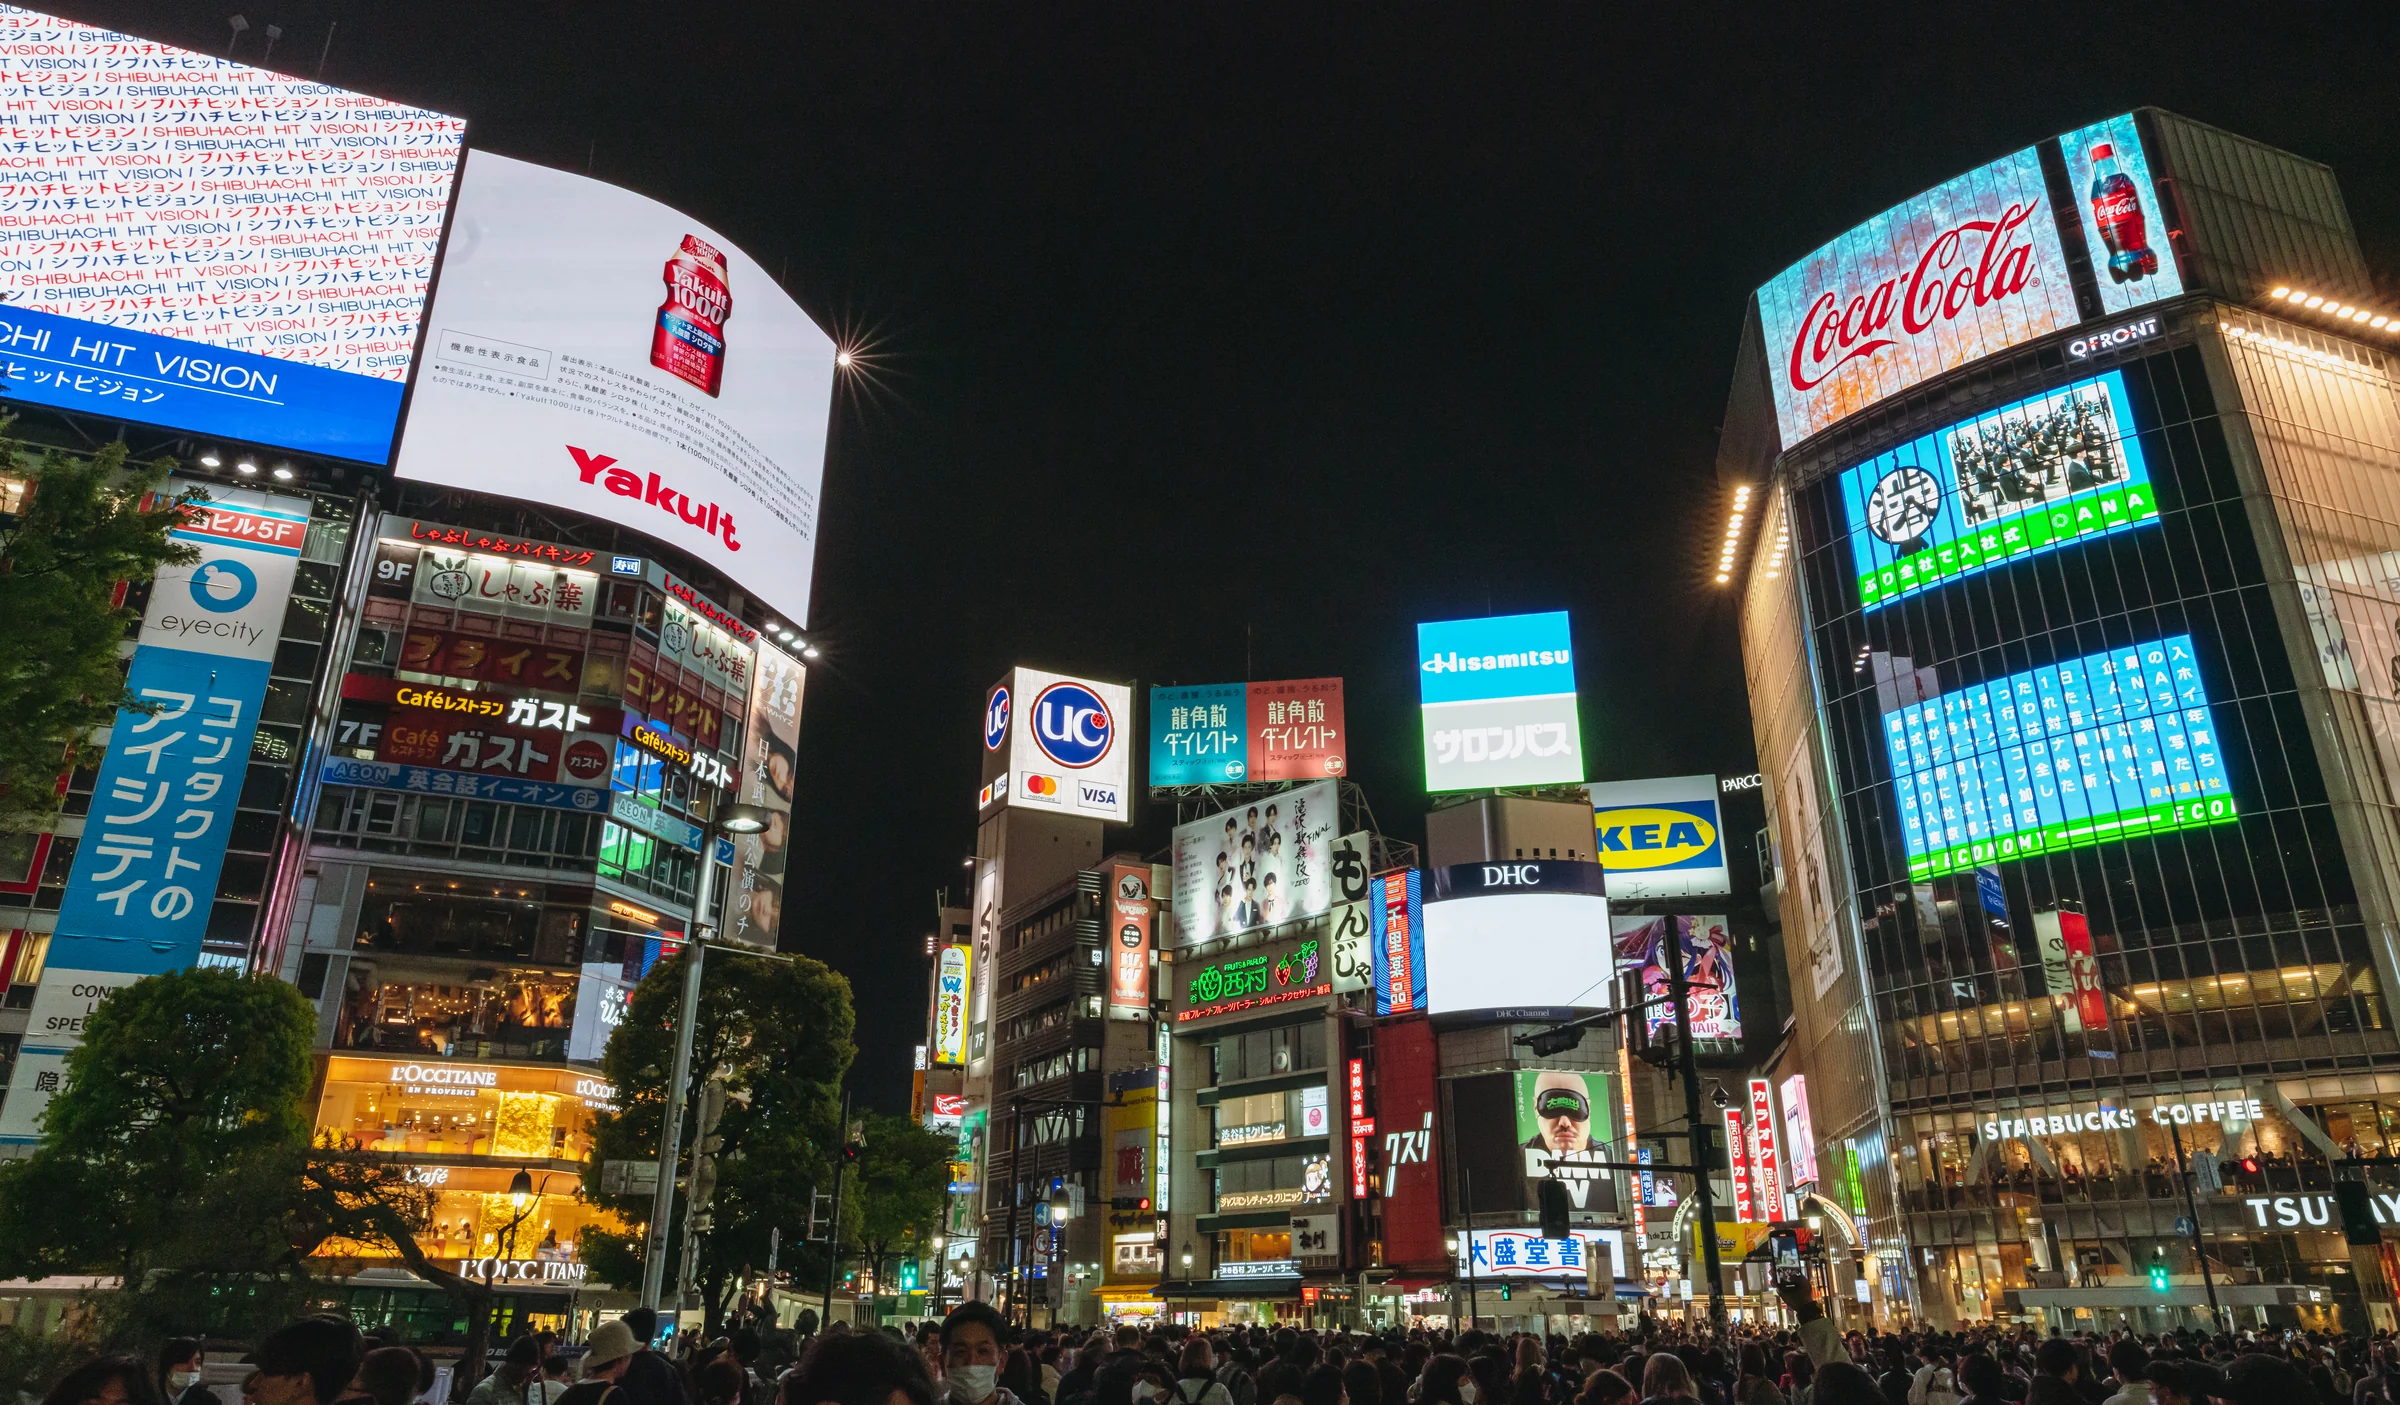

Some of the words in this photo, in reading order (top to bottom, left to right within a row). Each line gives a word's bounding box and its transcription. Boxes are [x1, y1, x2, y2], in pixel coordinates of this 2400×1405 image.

[105, 72, 219, 83] SHIBUHACHI
[228, 72, 254, 82] HIT
[7, 100, 36, 111] HIT
[49, 99, 113, 111] VISION
[132, 97, 319, 111] シブハチヒットビジョン
[154, 125, 265, 137] SHIBUHACHI
[275, 124, 300, 135] HIT
[312, 123, 369, 135] VISION
[56, 156, 86, 167] HIT
[98, 155, 161, 167] VISION
[180, 149, 365, 165] シブハチヒットビジョン
[672, 265, 728, 311] Yakult
[670, 283, 725, 326] 1000
[204, 323, 232, 335] HIT
[244, 319, 306, 333] VISION
[70, 336, 136, 367] HIT
[154, 351, 279, 396] VISION
[450, 342, 540, 368] 機能性表示食品
[565, 444, 742, 553] Yakult
[2077, 491, 2145, 523] ANA
[411, 521, 597, 567] しゃぶしゃぶバイキング
[377, 560, 413, 581] 9F
[614, 559, 640, 574] 寿司
[480, 569, 583, 612] しゃぶ葉
[664, 573, 757, 643] しゃぶしゃぶバイキング
[161, 615, 264, 646] eyecity
[407, 635, 574, 681] プライス
[692, 630, 747, 684] しゃぶ葉
[1422, 649, 1569, 674] Hisamitsu
[396, 687, 504, 717] Caféレストラン
[507, 698, 591, 732] ガスト
[626, 666, 717, 735] コンタクト
[1267, 699, 1325, 725] 龍角散
[988, 699, 1009, 737] UC
[1042, 701, 1105, 748] UC
[1172, 703, 1228, 730] 龍角散
[340, 720, 382, 746] 7F
[391, 727, 440, 747] Café
[1163, 730, 1239, 756] ダイレクト
[1260, 725, 1337, 751] ダイレクト
[1433, 722, 1573, 764] サロンパス
[390, 745, 437, 759] レストラン
[441, 731, 549, 774] ガスト
[569, 756, 603, 770] ガスト
[1172, 758, 1201, 766] スティック
[1269, 753, 1299, 762] スティック
[691, 752, 733, 789] ガスト
[332, 762, 390, 784] AEON
[407, 770, 565, 804] 英会話イーオン
[575, 791, 597, 807] 6F
[995, 778, 1008, 794] VISA
[1081, 787, 1117, 805] VISA
[2149, 777, 2222, 799] 時事通信社
[91, 688, 196, 917] アイシティ
[149, 696, 243, 921] コンタクトの
[618, 799, 648, 825] AEON
[1306, 822, 1332, 845] FINAL
[1944, 831, 2048, 868] ECONOMY
[1483, 865, 1540, 887] DHC
[1332, 839, 1371, 985] もんじゃ
[1384, 880, 1407, 1005] 三千里薬品
[72, 984, 114, 998] CON
[1224, 966, 1268, 997] 西村
[1496, 1009, 1516, 1018] DHC
[1516, 1008, 1550, 1018] Channel
[975, 1032, 985, 1049] 7F
[391, 1065, 497, 1086] L'OCCITANE
[408, 1086, 421, 1094] EN
[425, 1087, 476, 1096] PROVENCE
[1729, 1120, 1738, 1136] BIG
[1754, 1090, 1774, 1160] カラオケ
[1985, 1108, 2137, 1141] STARBUCKS
[2153, 1099, 2264, 1126] COFFEE
[1385, 1111, 1432, 1197] クスリ
[1733, 1136, 1741, 1158] ECHO
[1525, 1148, 1611, 1180] DMM
[1764, 1168, 1774, 1186] BIG
[405, 1167, 448, 1188] Café
[1734, 1166, 1753, 1223] カラオケ
[1768, 1186, 1778, 1213] ECHO
[1468, 1237, 1611, 1266] 大盛堂書
